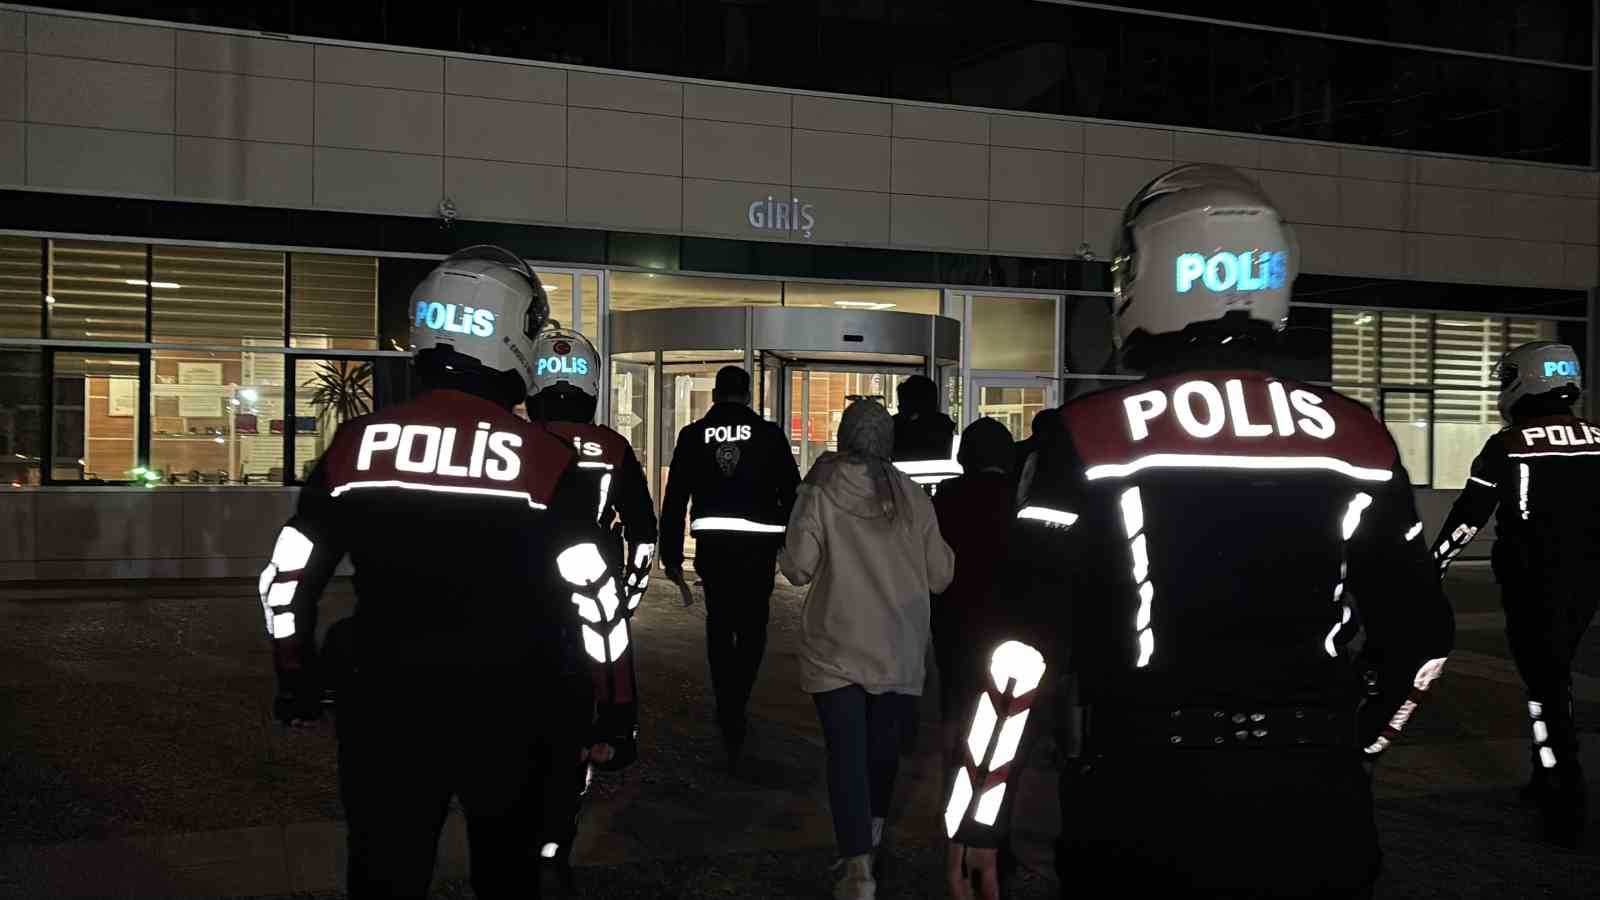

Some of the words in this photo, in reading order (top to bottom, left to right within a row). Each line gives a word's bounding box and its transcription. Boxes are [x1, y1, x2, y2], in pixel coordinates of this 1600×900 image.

[749, 196, 815, 239] GİRİŞ
[357, 421, 523, 481] POLİS
[705, 425, 751, 444] POLIS
